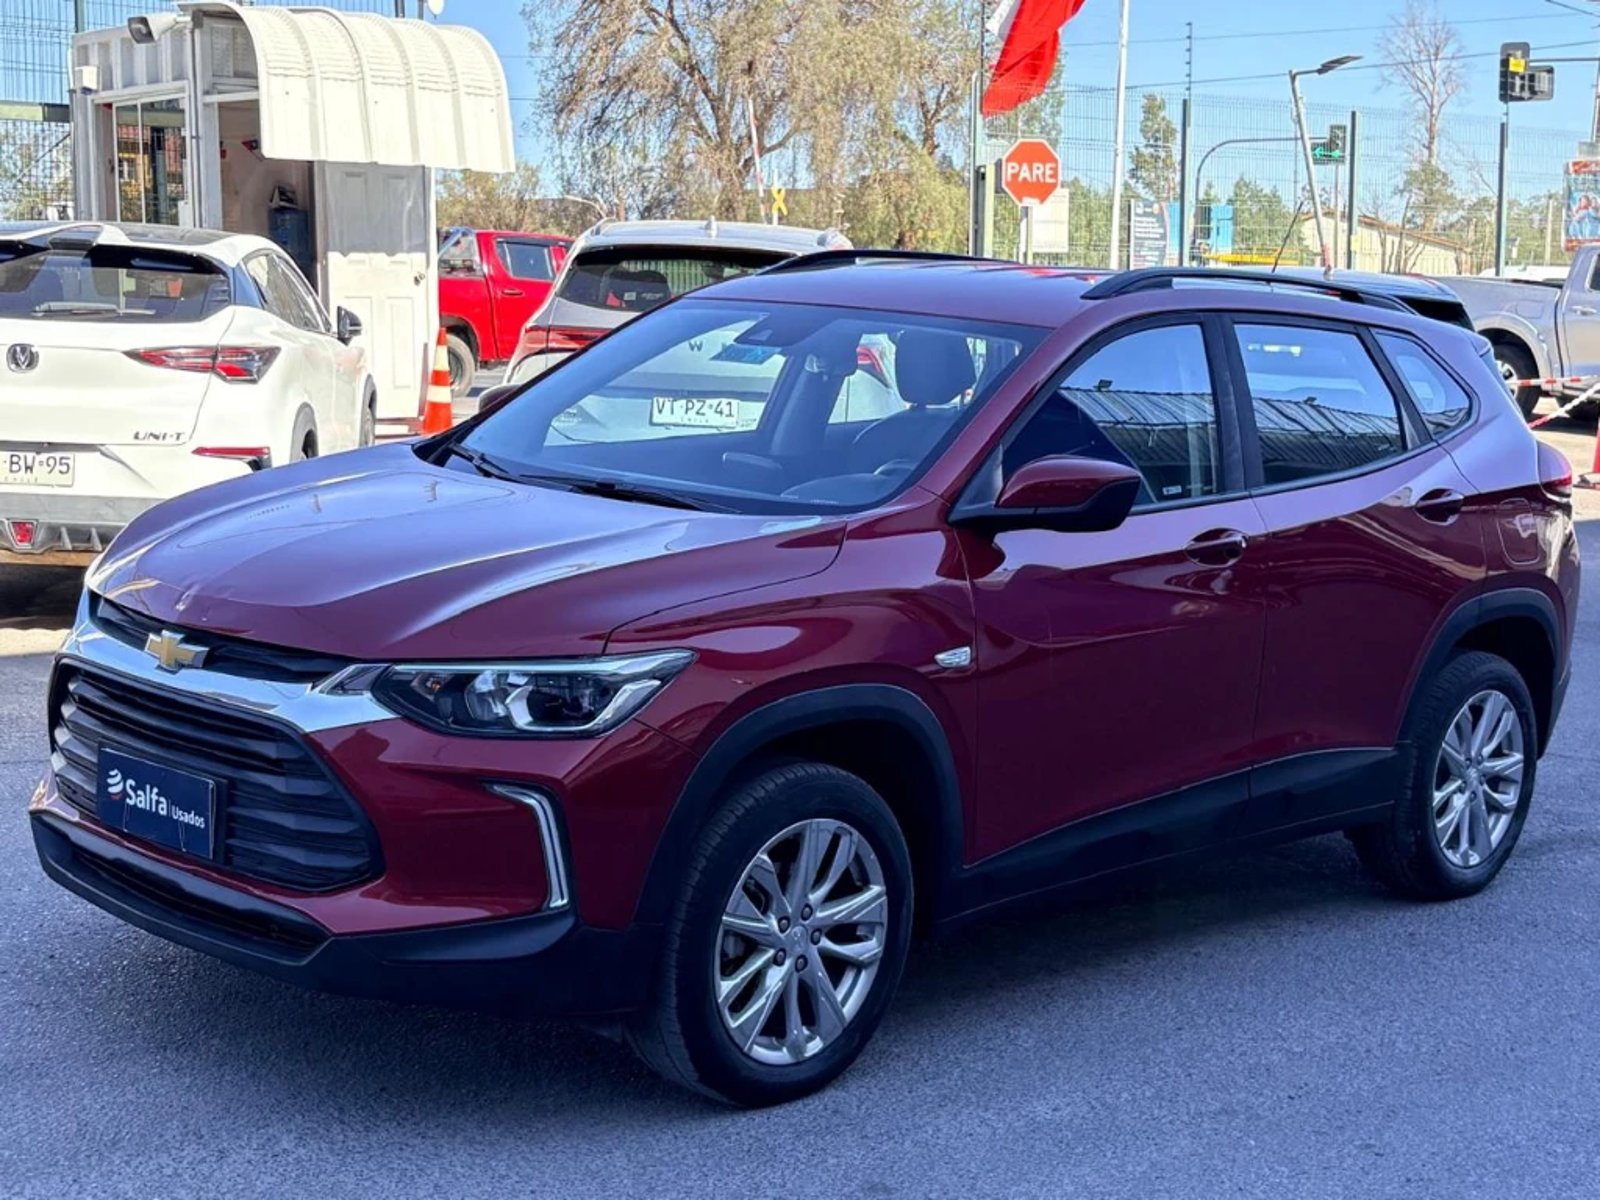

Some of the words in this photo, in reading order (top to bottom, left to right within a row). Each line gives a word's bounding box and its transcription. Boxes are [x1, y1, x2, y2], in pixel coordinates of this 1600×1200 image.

[1007, 162, 1057, 183] PARE
[125, 779, 168, 816] Salfa
[172, 805, 206, 830] Usados
